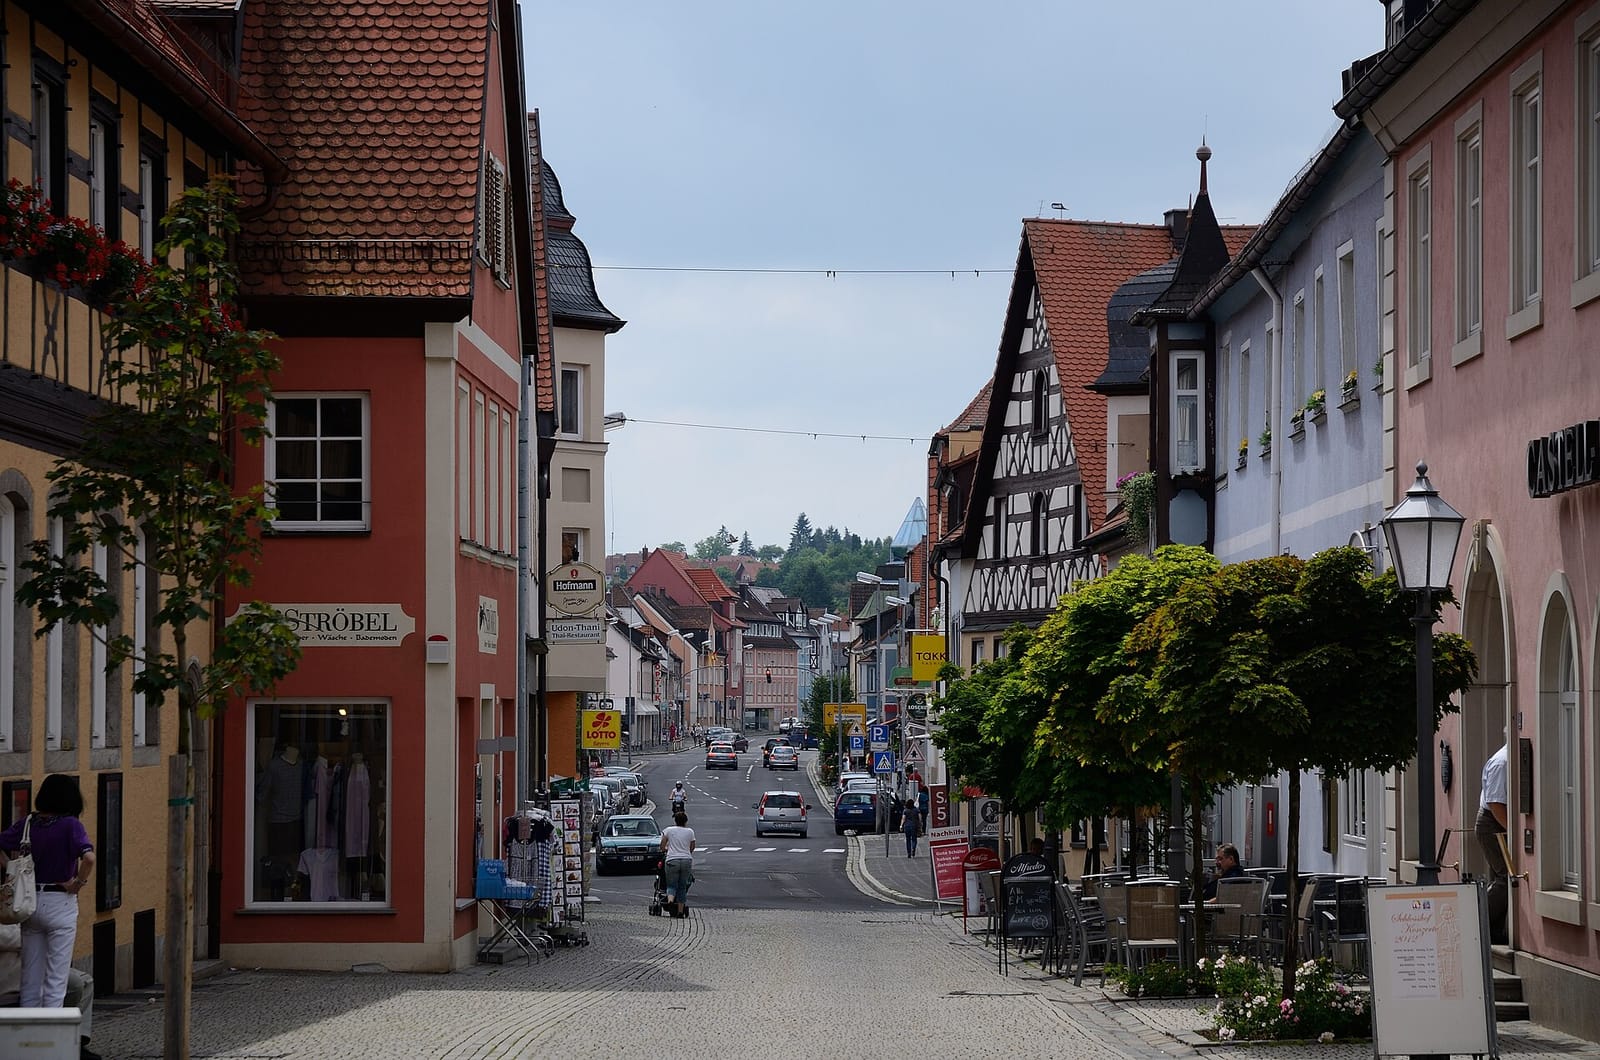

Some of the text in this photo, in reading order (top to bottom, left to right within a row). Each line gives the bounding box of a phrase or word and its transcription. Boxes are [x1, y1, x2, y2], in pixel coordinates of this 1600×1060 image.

[556, 581, 594, 590] Hofmann
[551, 624, 601, 632] Udon-Thani
[586, 731, 616, 739] LOTTO
[873, 727, 883, 741] P
[853, 737, 861, 748] P
[936, 791, 947, 804] S
[931, 828, 965, 838] Nachhilfe
[1010, 861, 1046, 874] Alfredo
